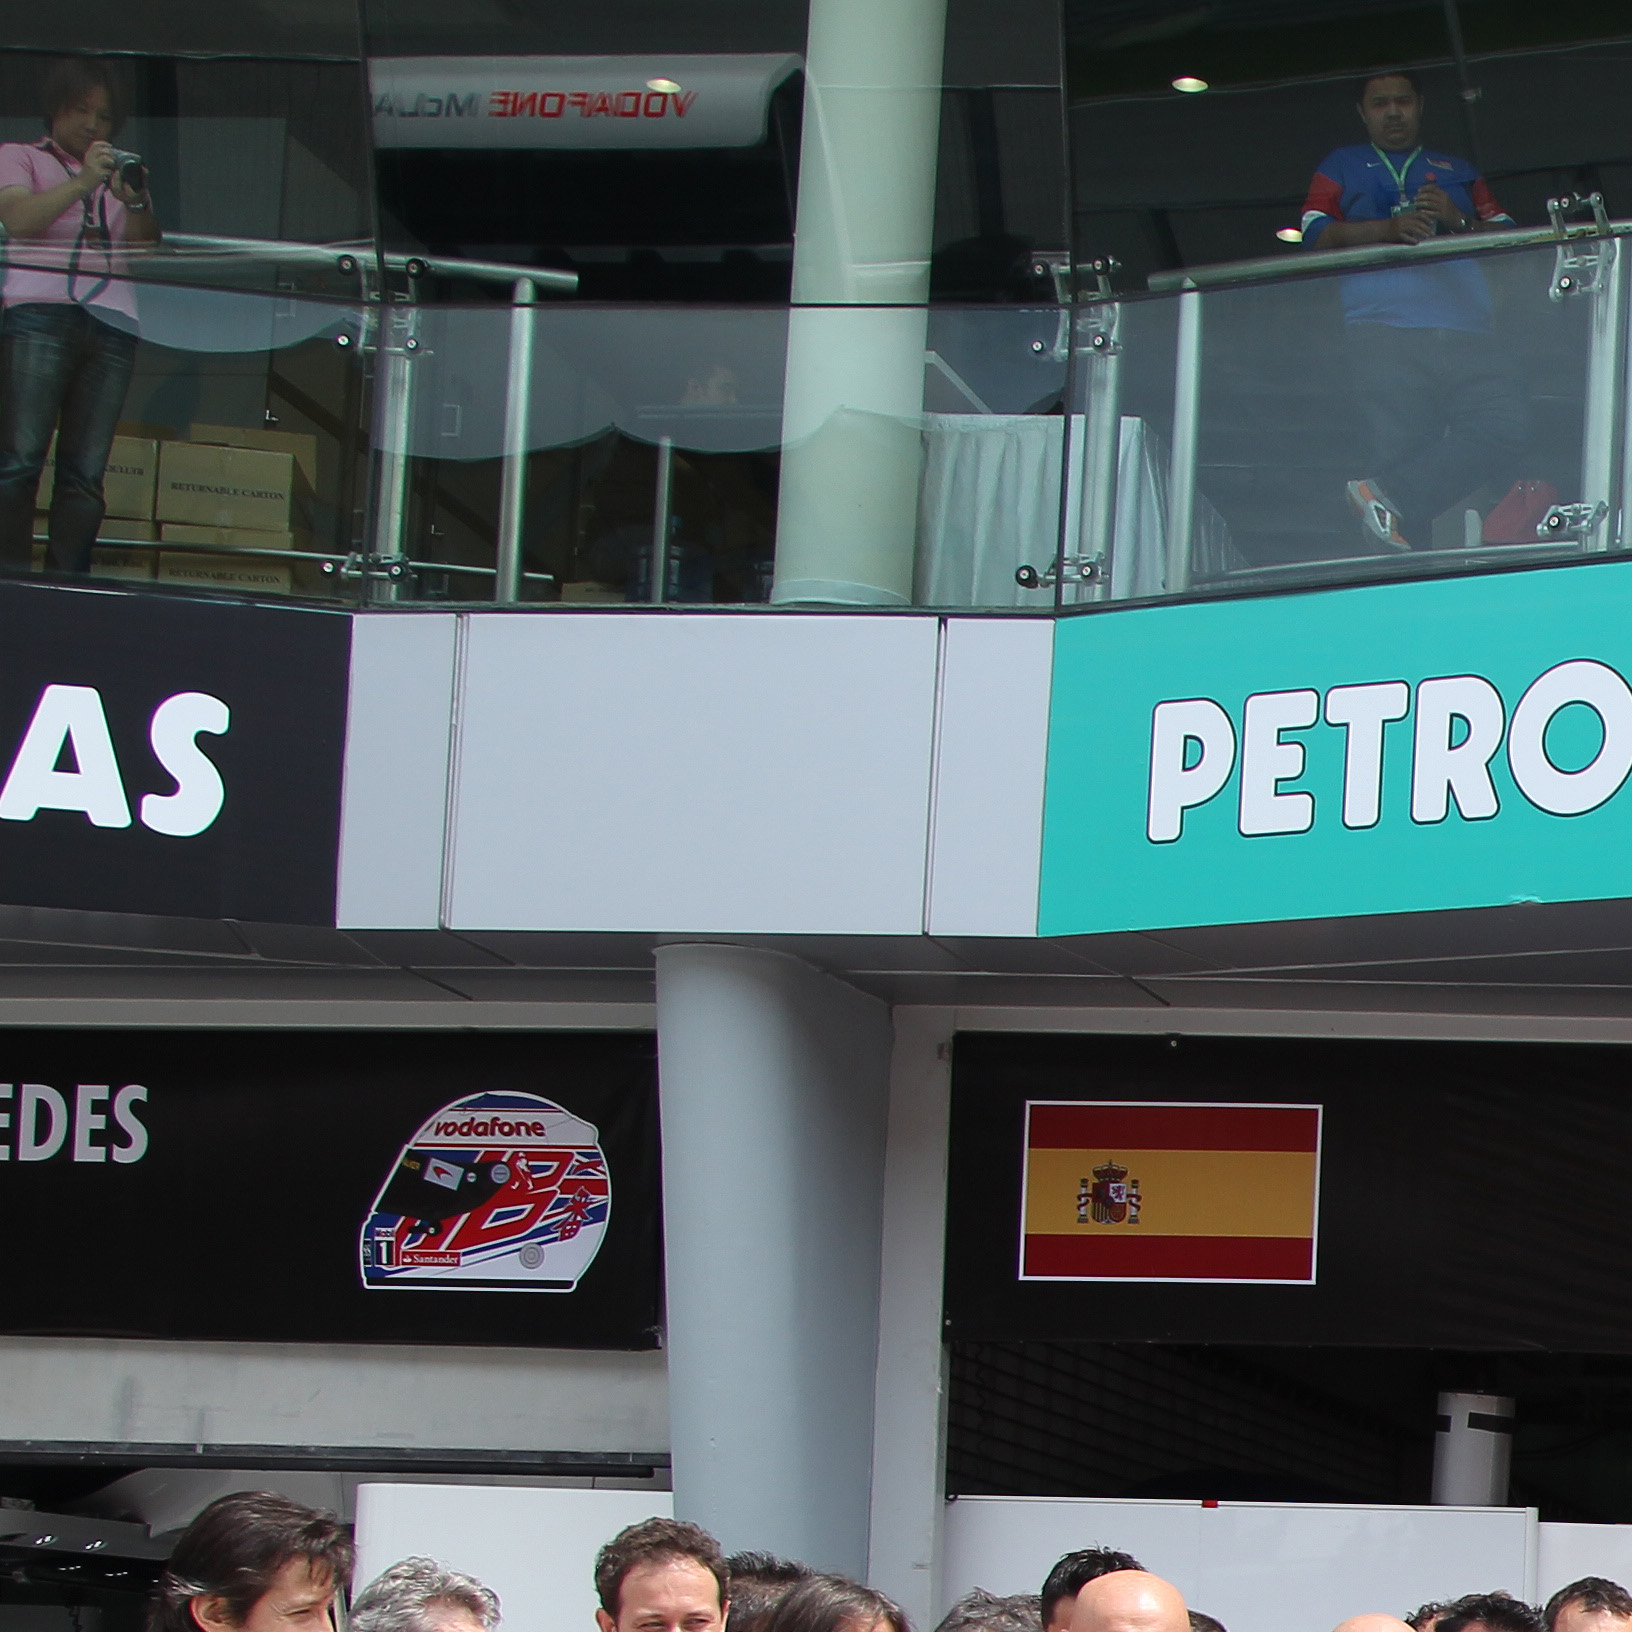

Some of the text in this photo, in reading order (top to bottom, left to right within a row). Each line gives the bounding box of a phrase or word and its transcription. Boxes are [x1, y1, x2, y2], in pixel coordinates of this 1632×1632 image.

[171, 481, 285, 501] RETURNABLE CARTON
[0, 684, 230, 838] AS
[433, 1117, 547, 1138] vodafone
[379, 1241, 389, 1265] 1
[413, 1252, 459, 1265] Santander
